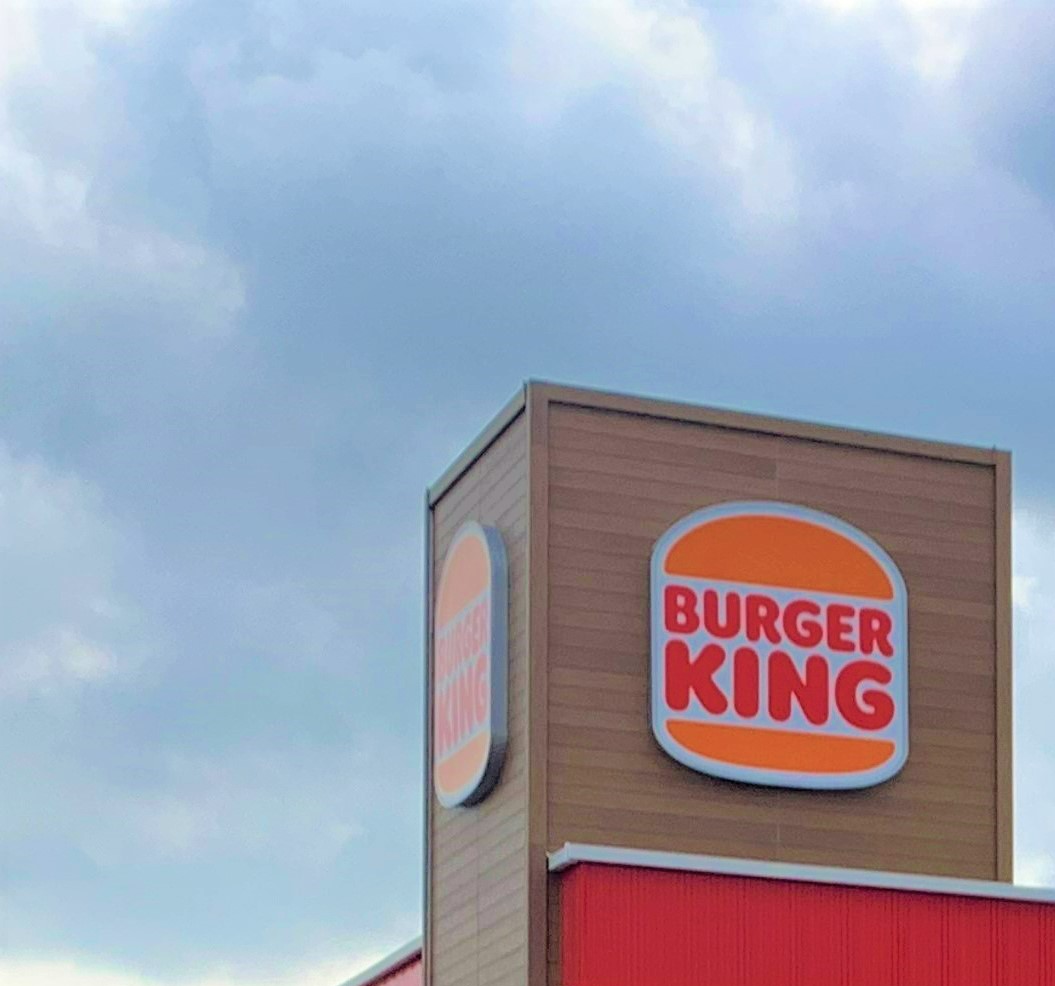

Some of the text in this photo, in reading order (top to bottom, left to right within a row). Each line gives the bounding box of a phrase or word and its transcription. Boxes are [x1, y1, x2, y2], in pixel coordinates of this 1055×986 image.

[436, 601, 487, 682] BURGER
[663, 583, 895, 657] BURGER
[436, 652, 487, 760] KING
[664, 640, 895, 731] KING
